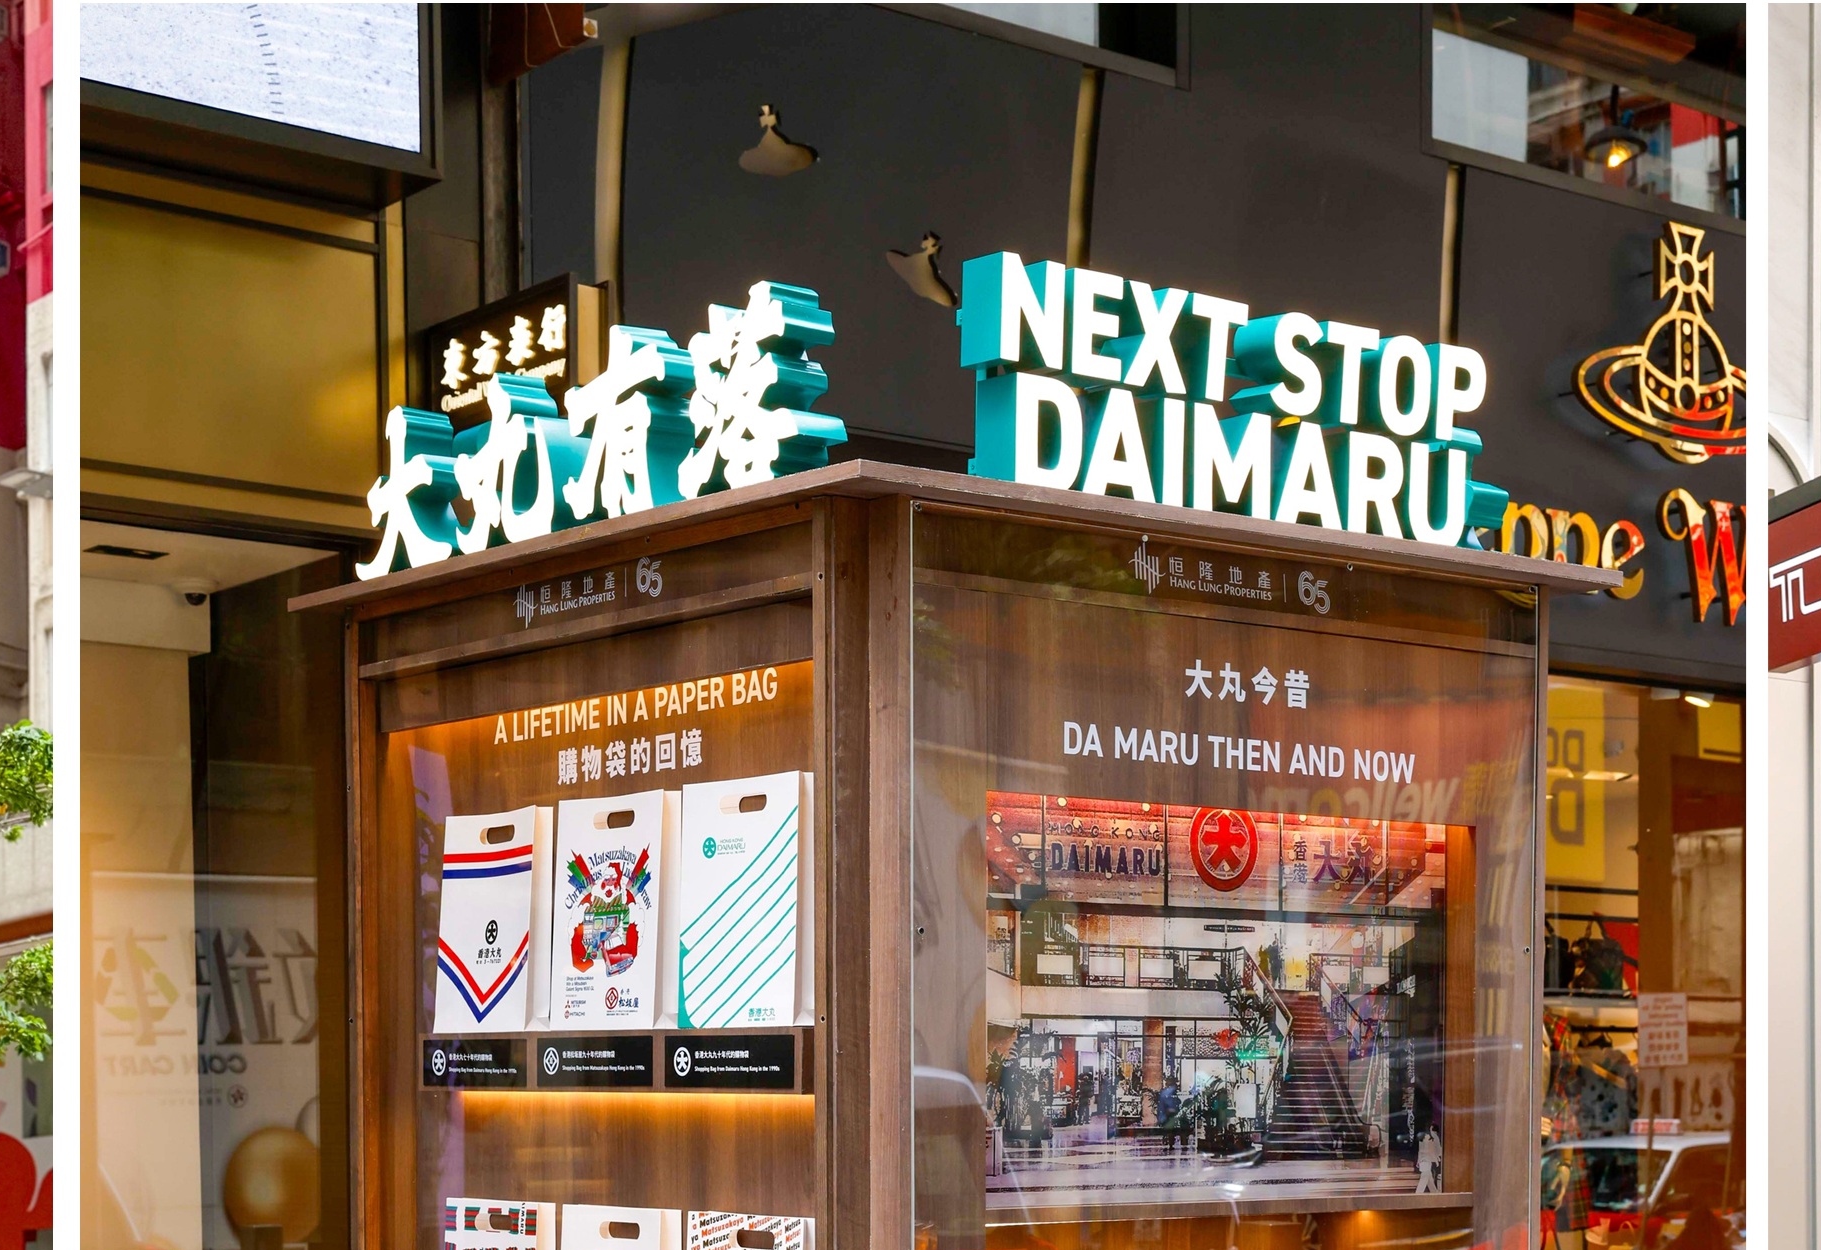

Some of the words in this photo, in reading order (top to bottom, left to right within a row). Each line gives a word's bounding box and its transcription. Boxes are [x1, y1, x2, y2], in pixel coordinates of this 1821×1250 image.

[1000, 251, 1249, 402] NEXT
[1273, 312, 1487, 438] STOP
[356, 280, 800, 581] 大丸有落
[1016, 371, 1467, 548] DAIMARU
[540, 571, 615, 603] 恒隆地產
[636, 557, 662, 597] 65
[1169, 556, 1271, 590] 恒隆地產
[1169, 576, 1196, 590] HANG
[1198, 580, 1223, 594] LUNG
[1224, 584, 1272, 601] PROPERTIES
[1298, 570, 1331, 615] 65
[540, 604, 559, 615] HANG
[560, 600, 578, 611] LUNG
[579, 591, 615, 607] PROPERTIES
[1185, 659, 1311, 710] 大丸今昔
[494, 715, 508, 745] A
[512, 697, 601, 741] LIFETIME
[607, 695, 627, 726] IN
[633, 691, 649, 721] A
[655, 676, 725, 719] PAPER
[732, 667, 778, 706] BAG
[557, 729, 704, 786] 購物袋的回憶
[1063, 721, 1104, 759] DA
[1114, 728, 1198, 767] MARU
[1208, 735, 1281, 774] THEN
[1289, 741, 1346, 779] AND
[1353, 746, 1416, 785] NOW
[1048, 821, 1104, 838] HONG
[1110, 825, 1162, 842] KONG
[1050, 842, 1163, 877] DAIMARU
[748, 1007, 776, 1018] 香港大丸
[701, 1216, 744, 1238] Matsuzakaya
